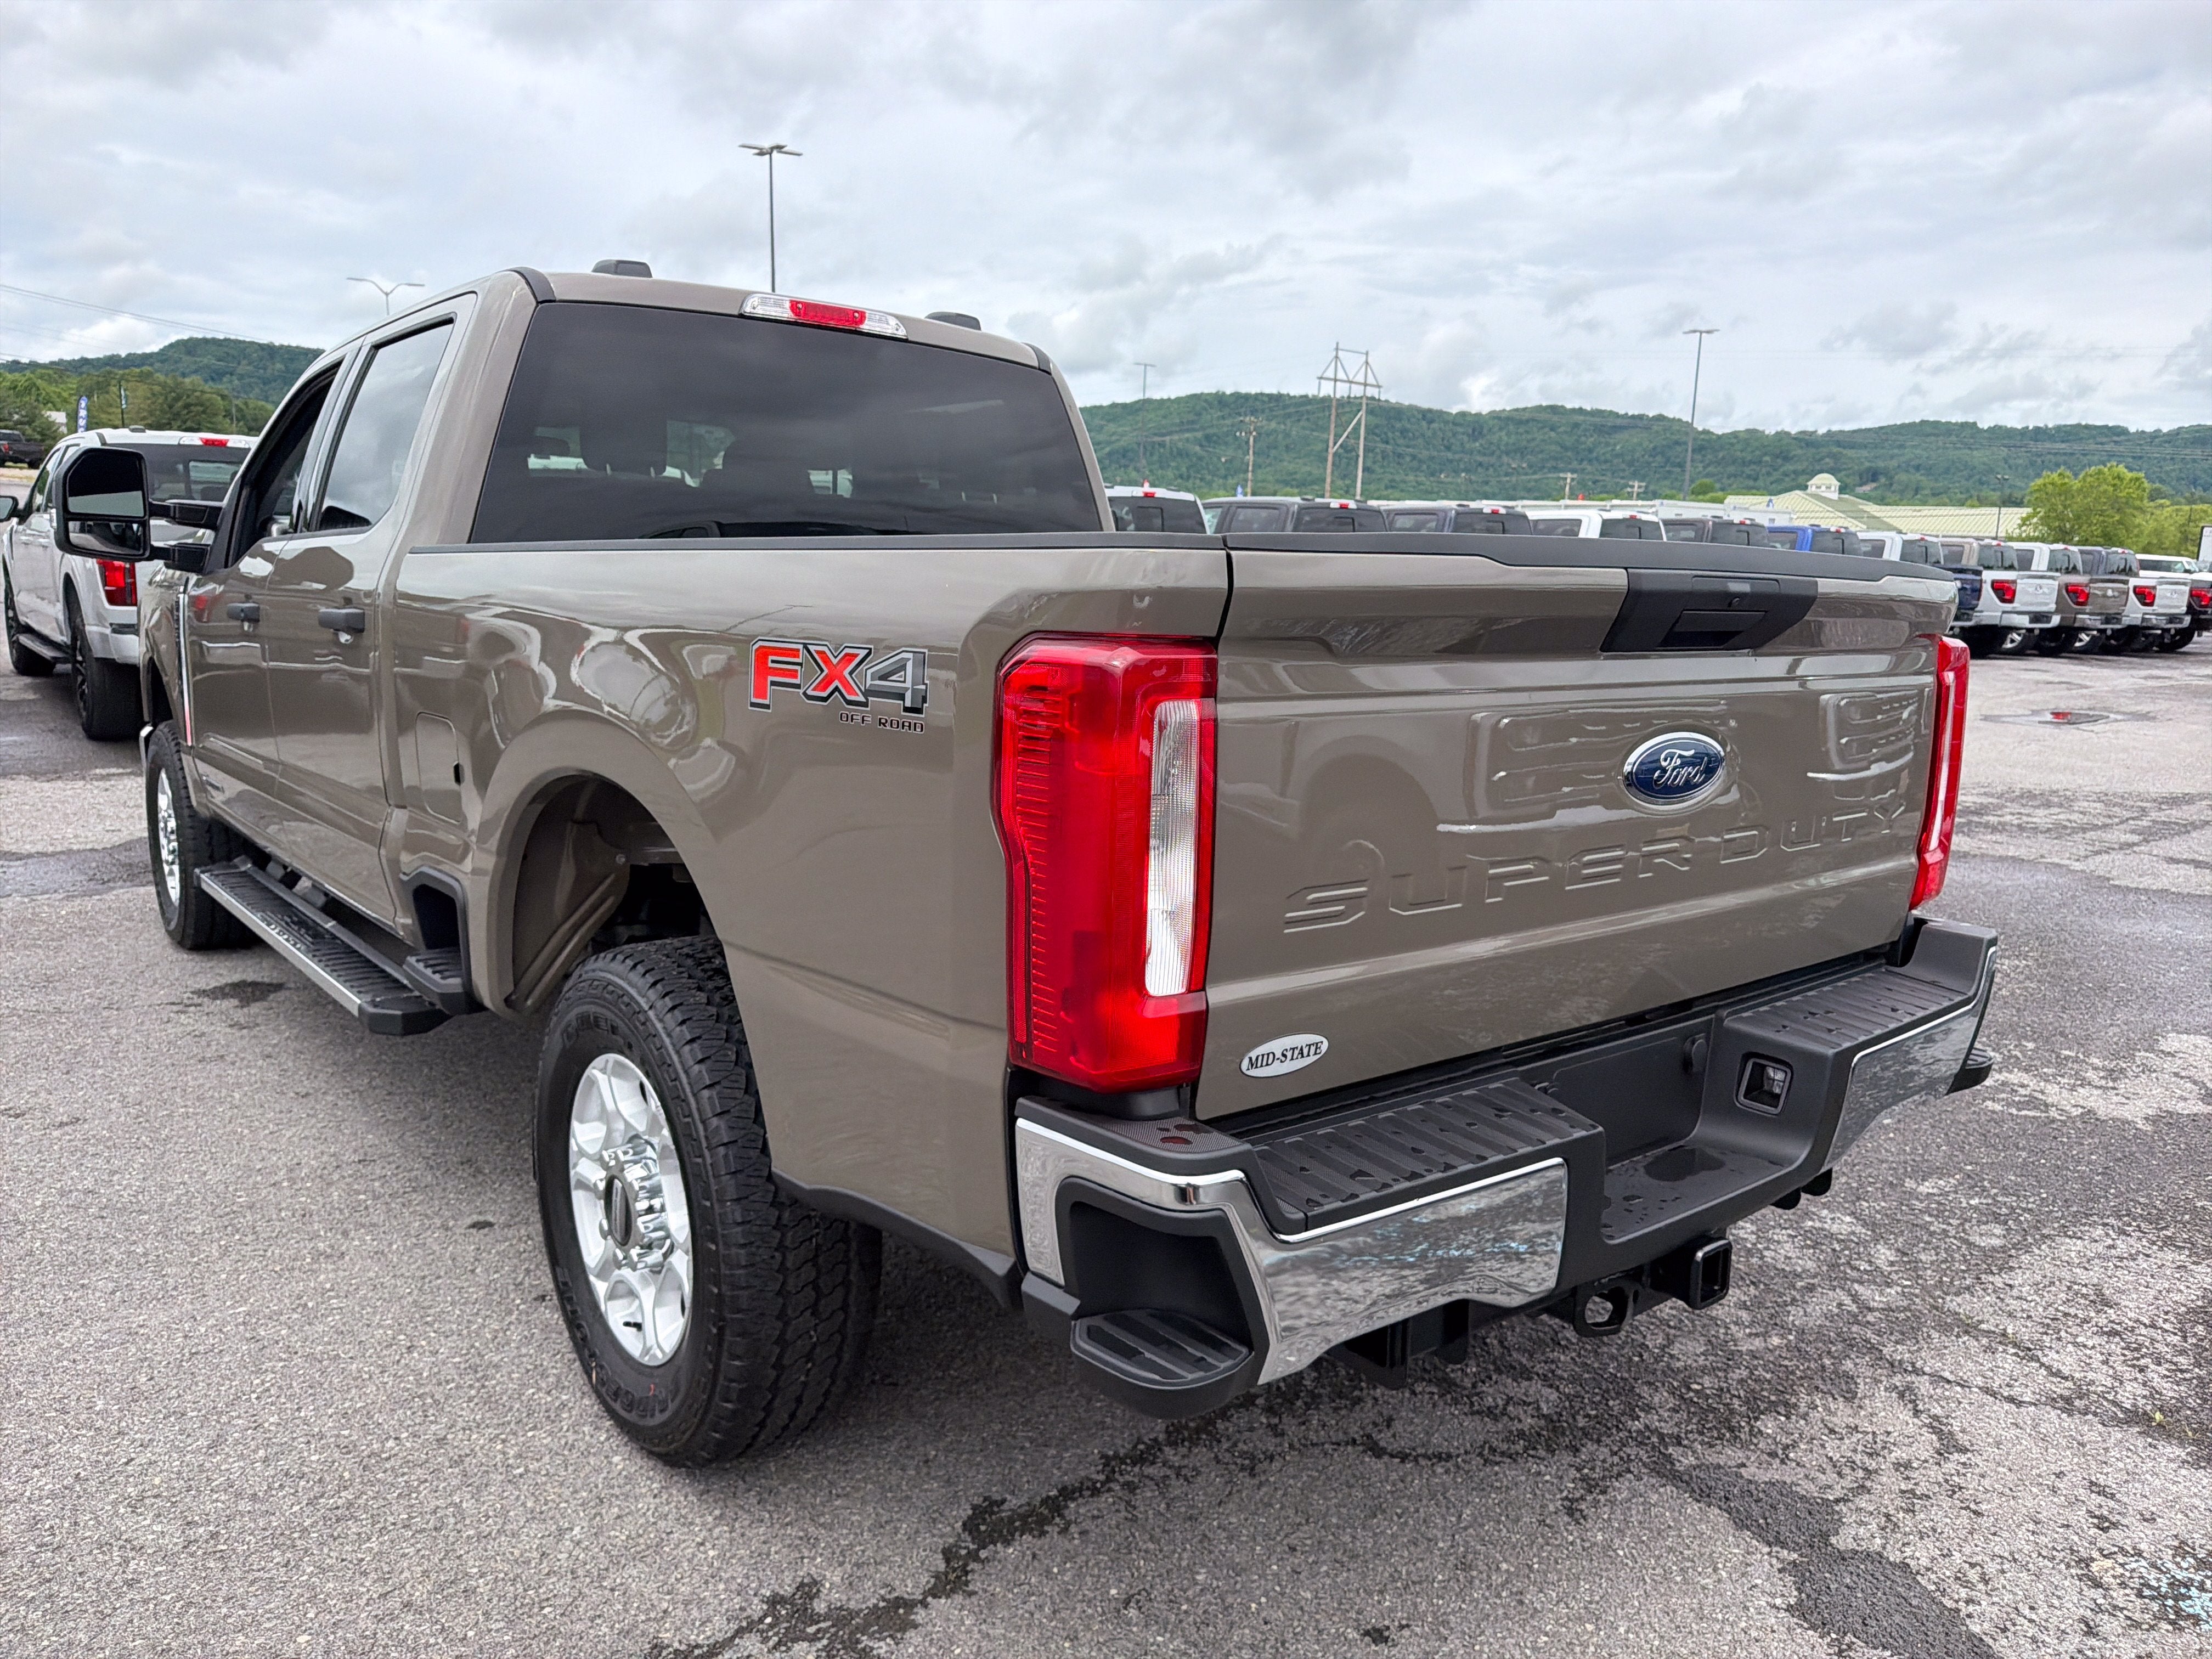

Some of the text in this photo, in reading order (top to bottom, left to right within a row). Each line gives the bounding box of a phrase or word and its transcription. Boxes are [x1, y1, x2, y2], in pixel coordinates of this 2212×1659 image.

[748, 637, 929, 717] FX4
[839, 711, 925, 733] OFF ROAD
[1653, 749, 1708, 789] Ford
[1283, 802, 1906, 933] SUPER DUTY
[1246, 1041, 1323, 1071] MID-STATE
